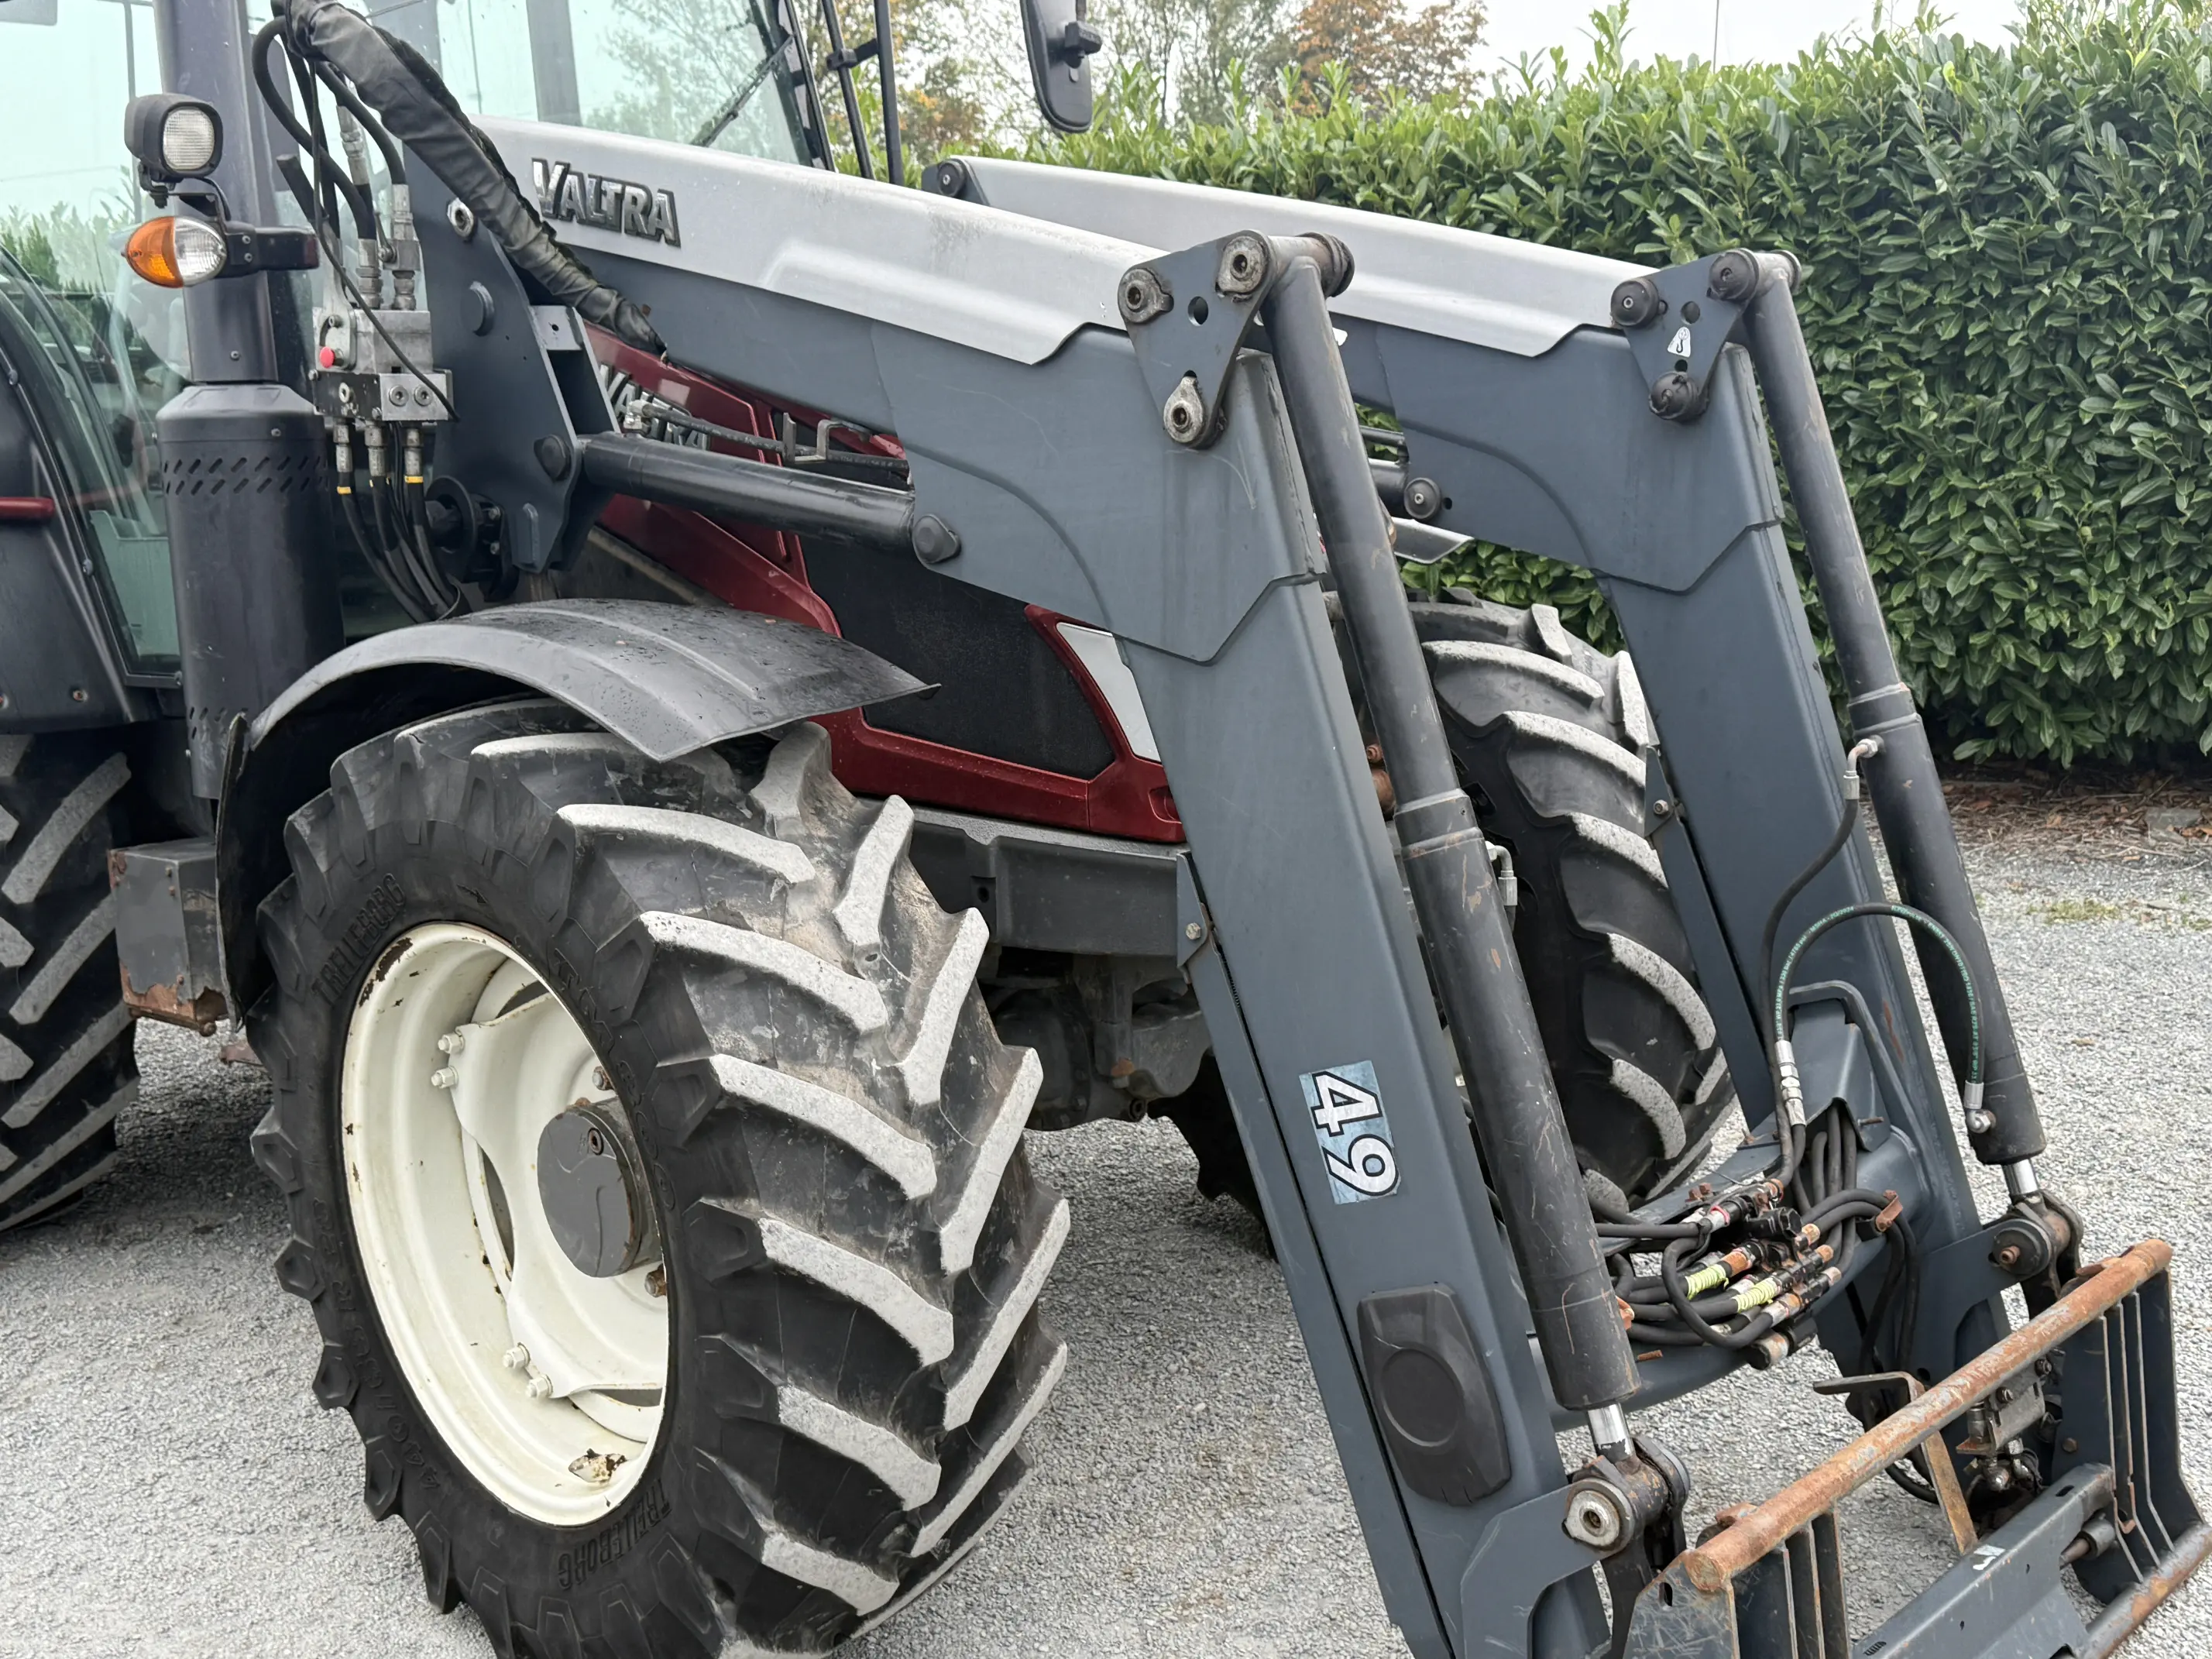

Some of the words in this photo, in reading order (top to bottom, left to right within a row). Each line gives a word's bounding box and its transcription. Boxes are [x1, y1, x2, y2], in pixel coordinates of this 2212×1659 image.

[531, 158, 682, 249] VALTRA
[311, 872, 407, 1008] TRELLEBORG
[1310, 1070, 1399, 1197] 49
[558, 1478, 672, 1592] TRELLEBORG
